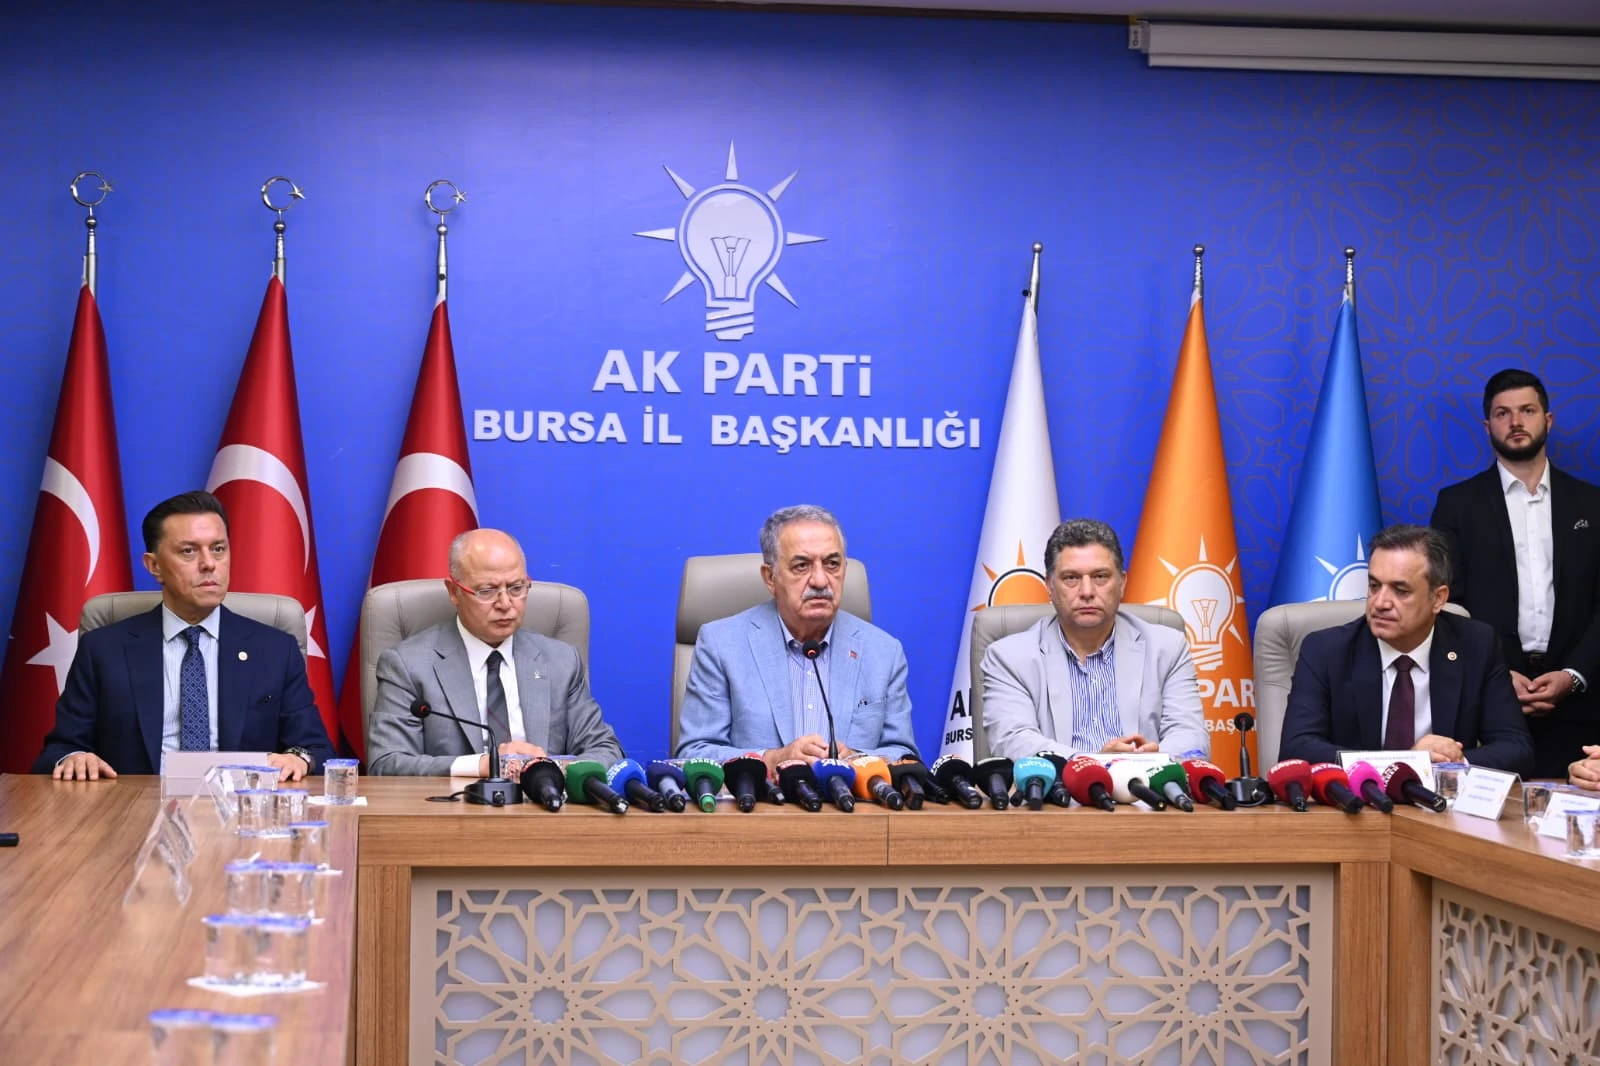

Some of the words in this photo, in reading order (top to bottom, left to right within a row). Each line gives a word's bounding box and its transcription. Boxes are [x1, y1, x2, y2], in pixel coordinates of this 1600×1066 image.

[593, 350, 681, 394] AK
[473, 410, 627, 443] BURSA
[643, 406, 682, 444] İL
[711, 411, 980, 455] BAŞKANLIĞI
